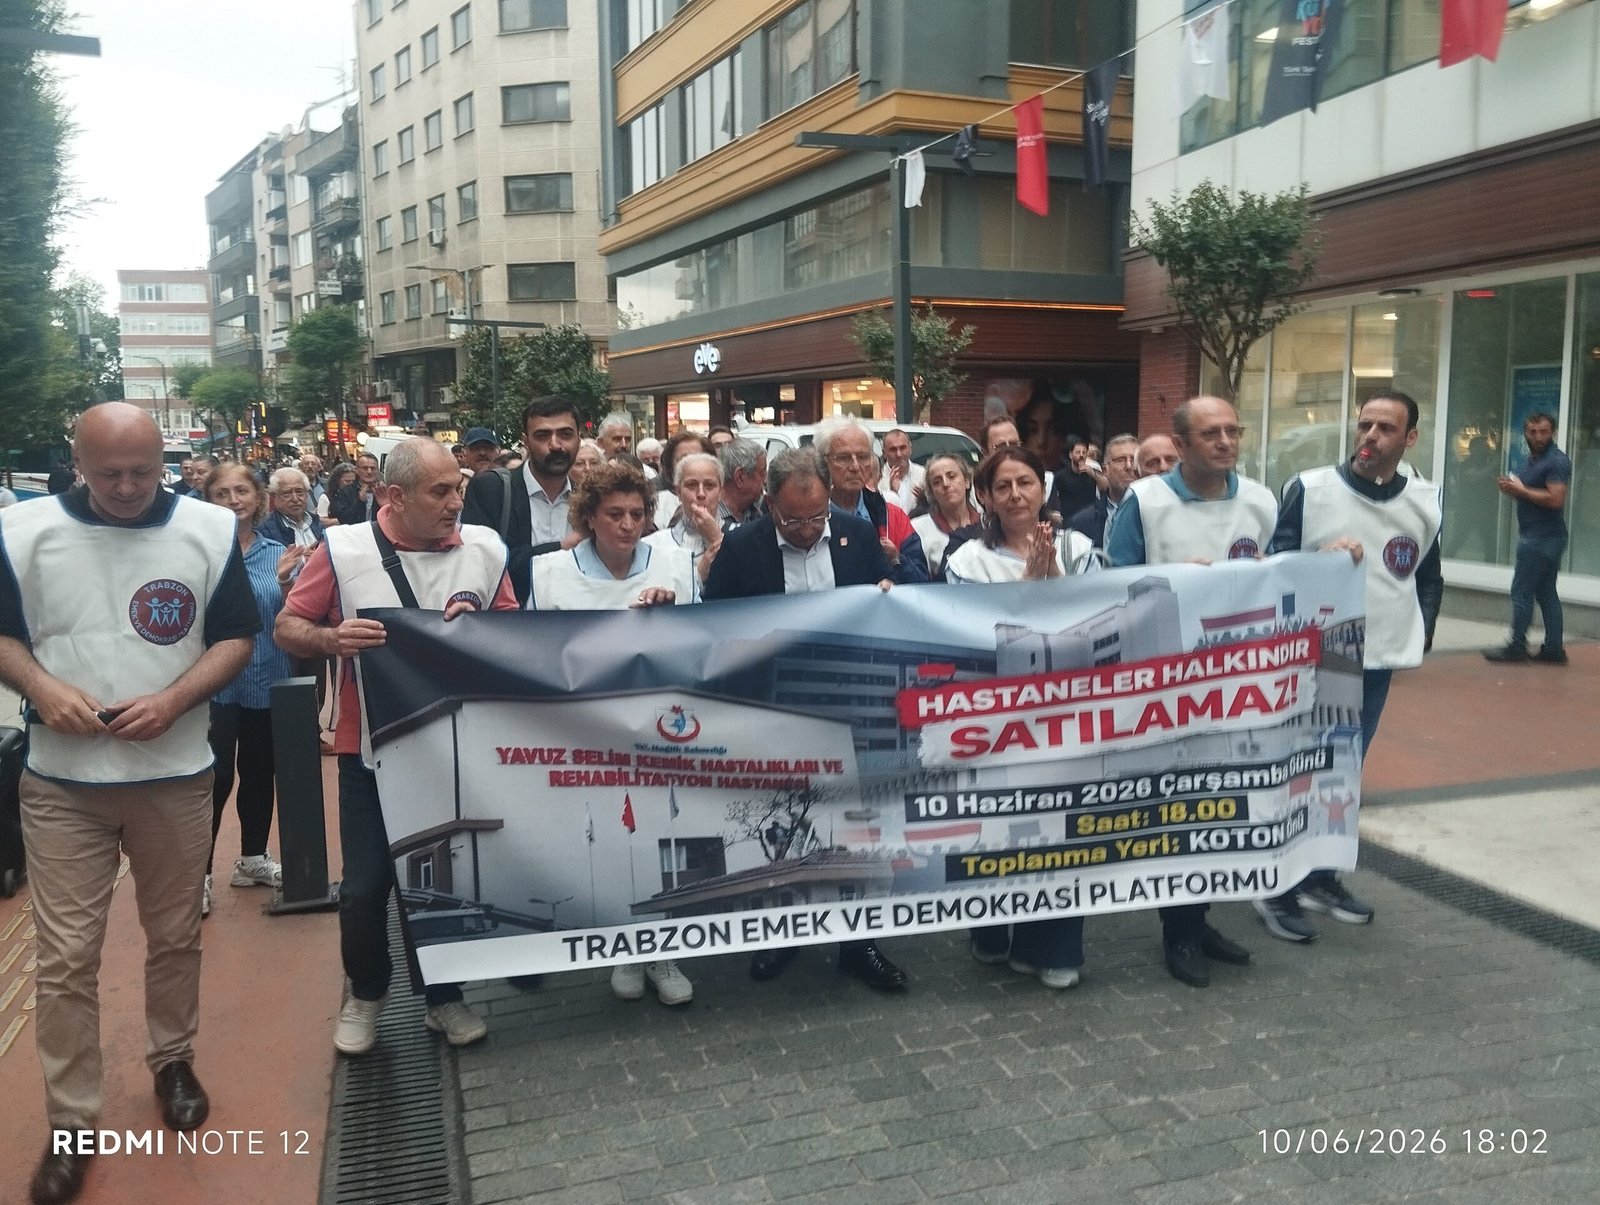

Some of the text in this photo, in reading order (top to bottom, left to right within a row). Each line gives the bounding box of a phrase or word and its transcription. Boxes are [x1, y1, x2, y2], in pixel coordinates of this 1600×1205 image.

[694, 342, 721, 374] eve
[143, 581, 189, 597] TRABZON
[131, 600, 140, 620] EMEK
[135, 619, 143, 630] VE
[918, 637, 1311, 719] HASTANELER HALKINDIR
[950, 672, 1301, 761] SATILAMAZ!
[496, 747, 844, 775] YAVUZ SELİM KEMİK HASTALIKLARI VE
[549, 767, 713, 788] REHABİLİTASYON
[914, 749, 1327, 818] 10 Haziran 2026 Çarşamba Günü
[1076, 799, 1237, 836] Saat: 18.00
[961, 841, 1107, 878] Toplanma
[1114, 835, 1181, 861] Yeri:
[1189, 821, 1285, 852] KOTON
[562, 866, 1280, 962] TRABZON EMEK VE DEMOKRASİ PLATFORMU
